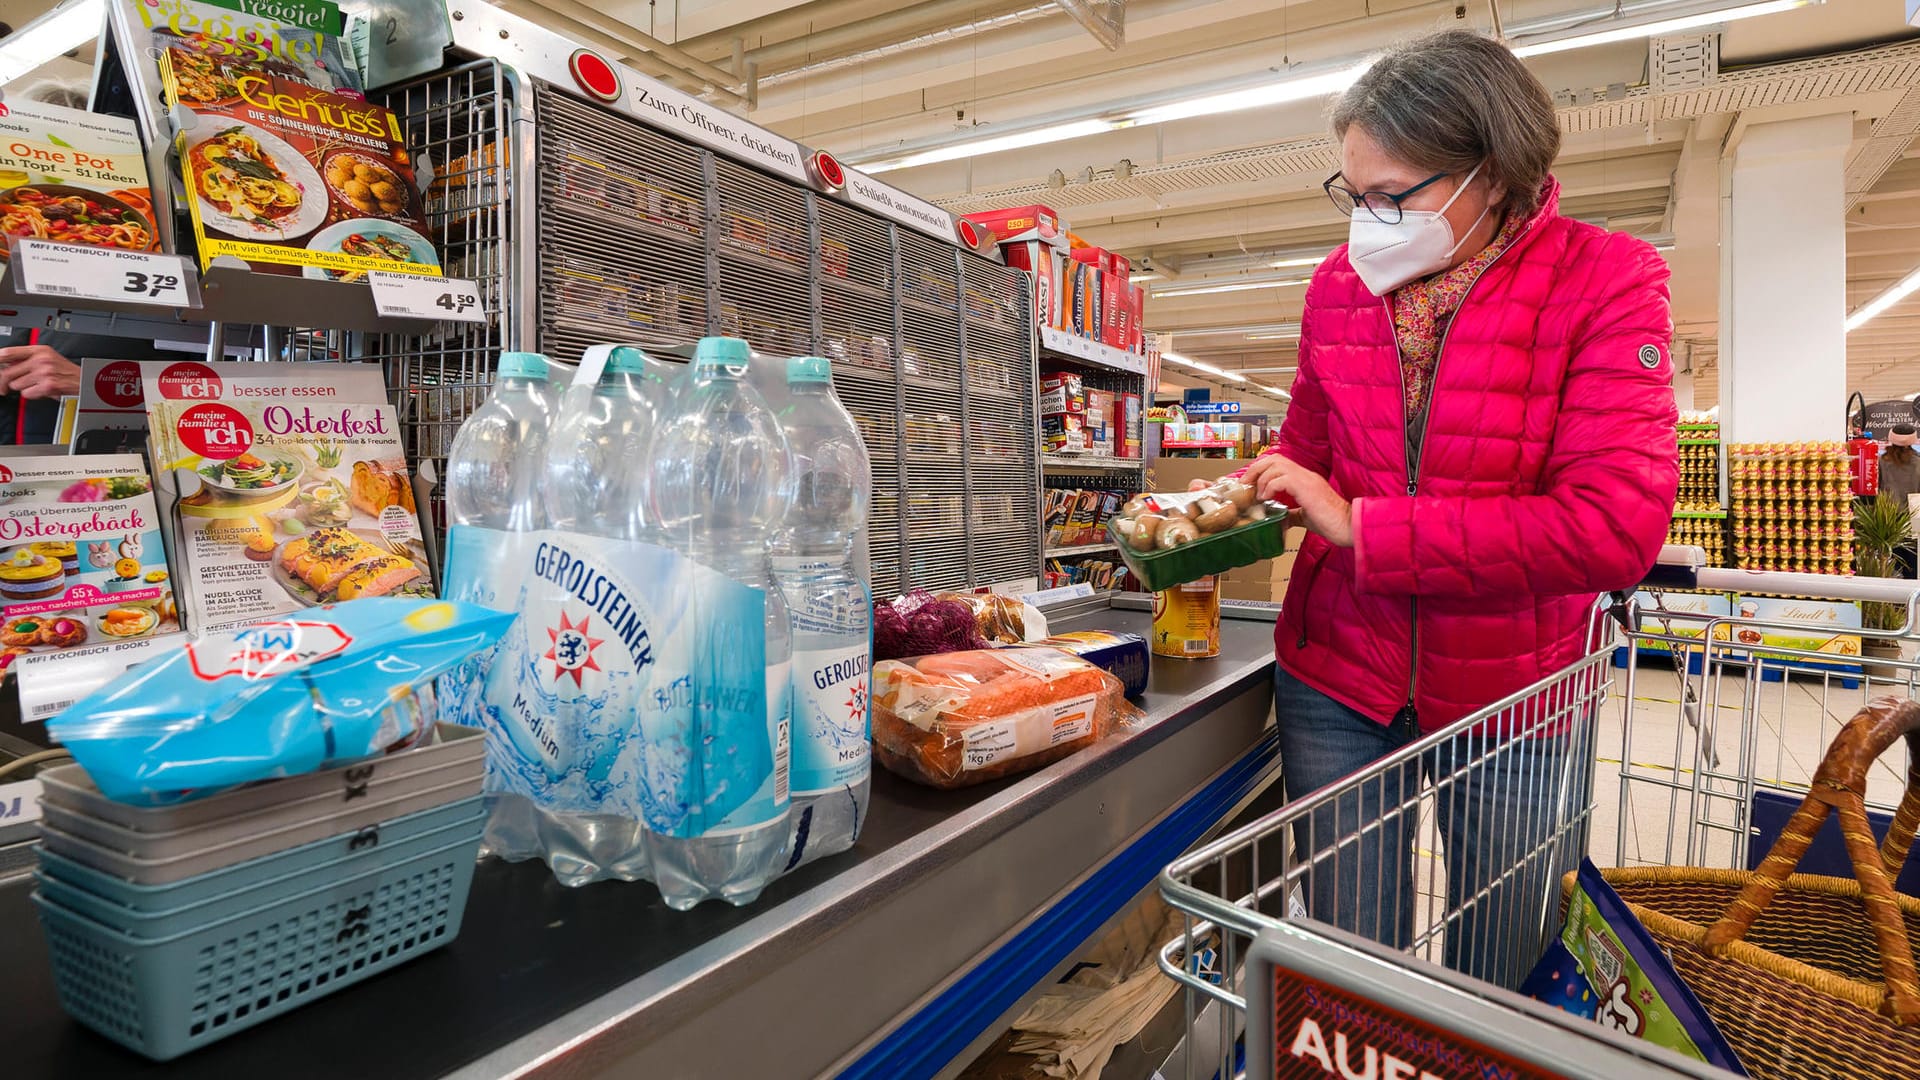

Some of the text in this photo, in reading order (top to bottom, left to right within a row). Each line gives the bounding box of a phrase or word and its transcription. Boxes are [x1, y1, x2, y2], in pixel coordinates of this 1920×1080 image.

[239, 0, 327, 28] eggie!
[385, 17, 397, 46] 2
[11, 109, 41, 119] besser
[43, 115, 69, 125] essen
[79, 122, 107, 132] besser
[109, 127, 133, 137] leben
[248, 109, 267, 122] DIE
[268, 114, 342, 140] SONNENKÜCHE
[344, 132, 389, 150] SIZILIENS
[635, 86, 797, 167] Zum Öffnen: drücken!
[10, 143, 115, 171] One Pot
[19, 159, 57, 173] Topf
[76, 168, 93, 178] 51
[96, 171, 138, 185] Ideen
[853, 180, 947, 230] Schließt automatisch!
[53, 244, 110, 257] KOCHBUCH
[116, 252, 150, 262] BOOKS
[218, 241, 237, 251] Mit
[241, 245, 261, 254] viel
[263, 246, 313, 261] Gemüse,
[316, 252, 348, 265] Pasta,
[350, 256, 378, 268] Fisch
[380, 261, 398, 271] und
[400, 263, 434, 274] Fleisch
[1039, 281, 1049, 326] West
[1073, 274, 1085, 337] Columbus
[1093, 280, 1101, 341] Columbus
[109, 369, 136, 377] meine
[161, 376, 196, 384] Familie
[172, 370, 201, 378] meine
[181, 378, 221, 399] ich
[233, 384, 336, 397] besser essen
[1041, 396, 1063, 406] uchen
[178, 418, 221, 429] Familie
[193, 411, 227, 420] meine
[263, 405, 389, 438] Osterfest
[204, 420, 251, 445] ich
[255, 433, 275, 446] 34
[276, 437, 319, 446] Top-Ideen
[332, 437, 360, 445] Familie
[368, 437, 397, 445] Freunde
[15, 470, 45, 478] besser
[48, 469, 74, 477] essen
[2, 488, 37, 498] books
[9, 503, 128, 518] Süße Überraschungen
[0, 508, 146, 541] Ostergebäck
[200, 562, 271, 573] GESCHNETZELTES
[201, 572, 217, 580] MIT
[9, 590, 156, 615] backen, naschen, Freude machen
[71, 588, 86, 599] 55
[204, 588, 263, 599] NUDEL-GLÜCK
[205, 595, 262, 606] IM ASIA-STYLE
[535, 542, 654, 675] GEROLSTEINER
[1782, 605, 1825, 620] Lindt
[26, 640, 150, 665] MFI KOCHBUCH BOOKS
[512, 692, 560, 760] Medium
[967, 753, 984, 765] 1kg
[1304, 983, 1515, 1080] Supermarkt-W
